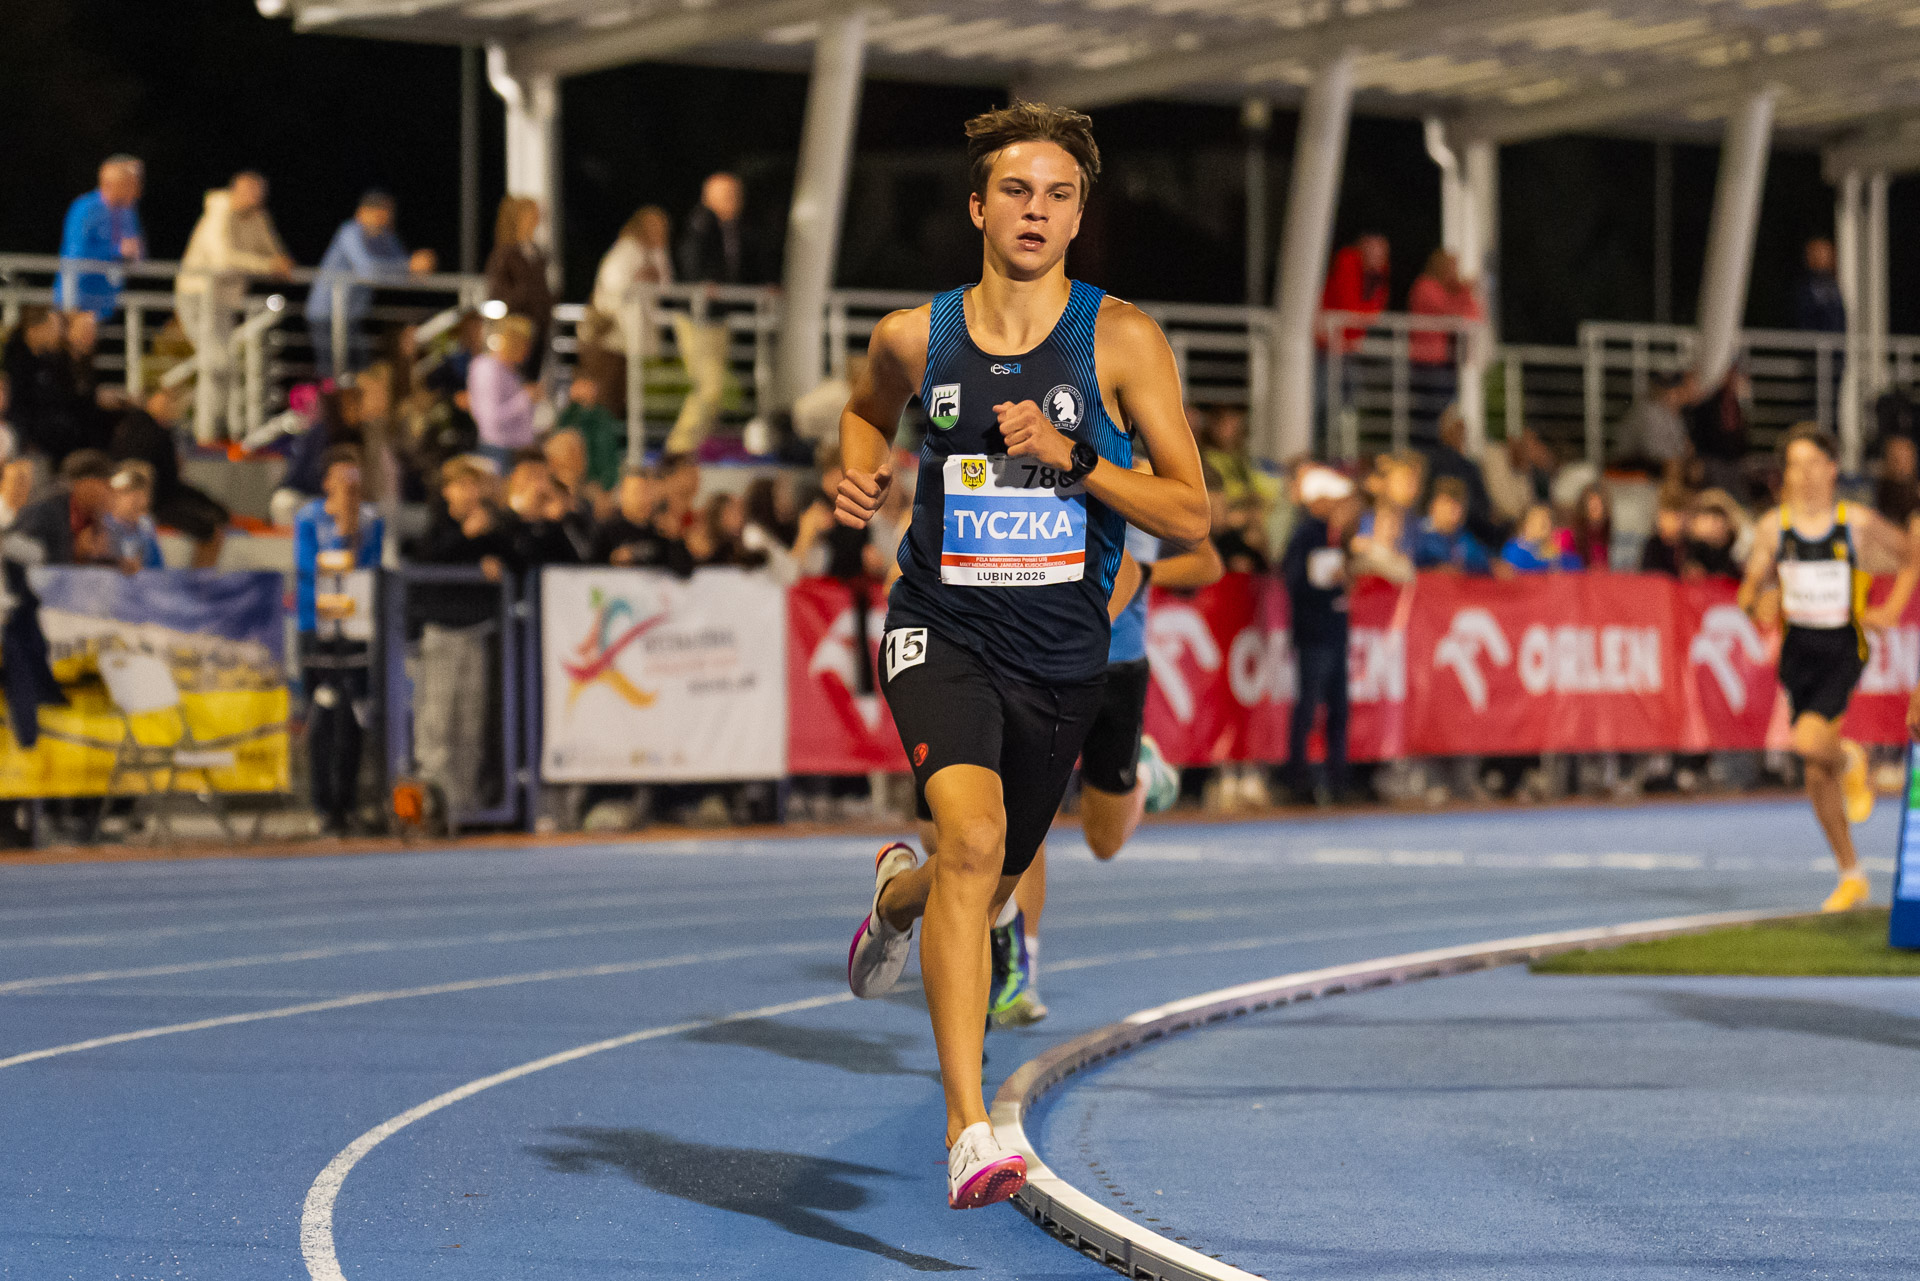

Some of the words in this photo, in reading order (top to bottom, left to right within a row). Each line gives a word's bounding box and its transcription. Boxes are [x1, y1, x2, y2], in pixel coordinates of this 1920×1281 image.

[953, 509, 1073, 540] TYCZKA
[977, 572, 1013, 581] LUBIN
[1015, 571, 1046, 581] 2026
[887, 629, 924, 670] 15
[1518, 623, 1662, 696] ORLEN
